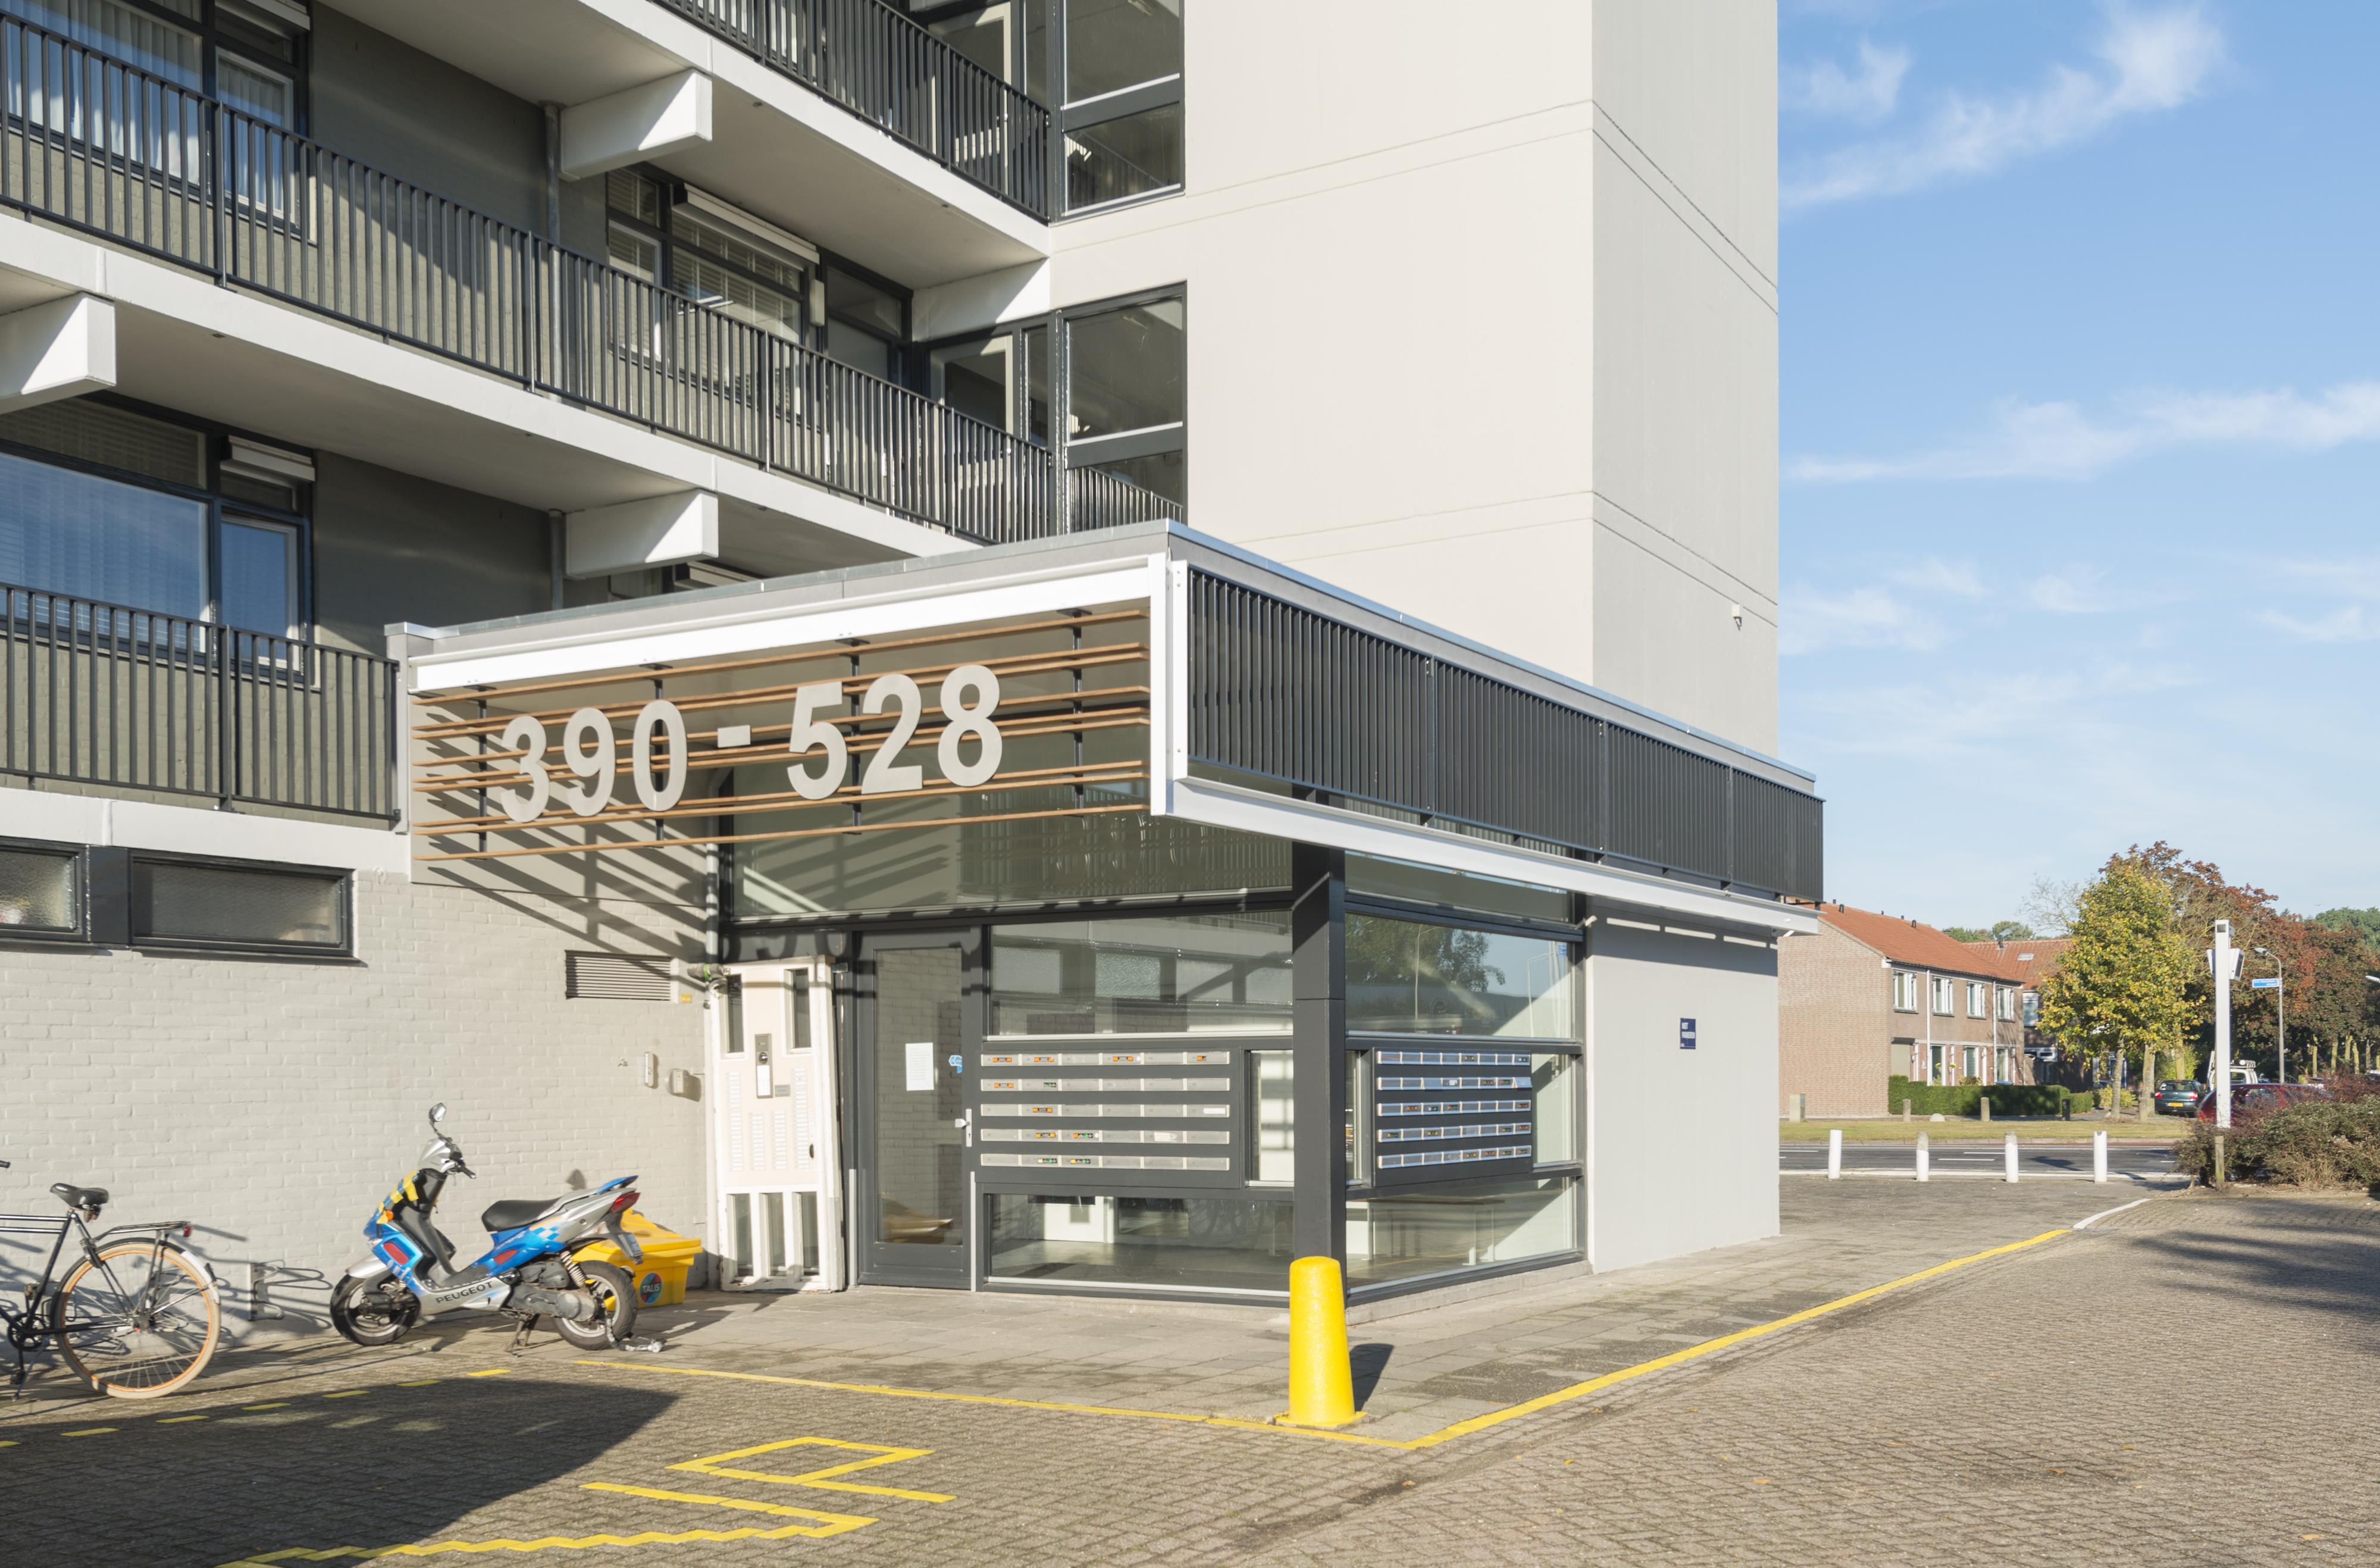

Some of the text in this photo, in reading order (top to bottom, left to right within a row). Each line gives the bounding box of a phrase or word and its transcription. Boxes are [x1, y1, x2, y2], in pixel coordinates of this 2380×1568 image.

[501, 700, 688, 824] 390
[787, 663, 1003, 800] 528
[436, 1281, 492, 1303] PEUGEOT
[643, 1283, 660, 1292] TALIS
